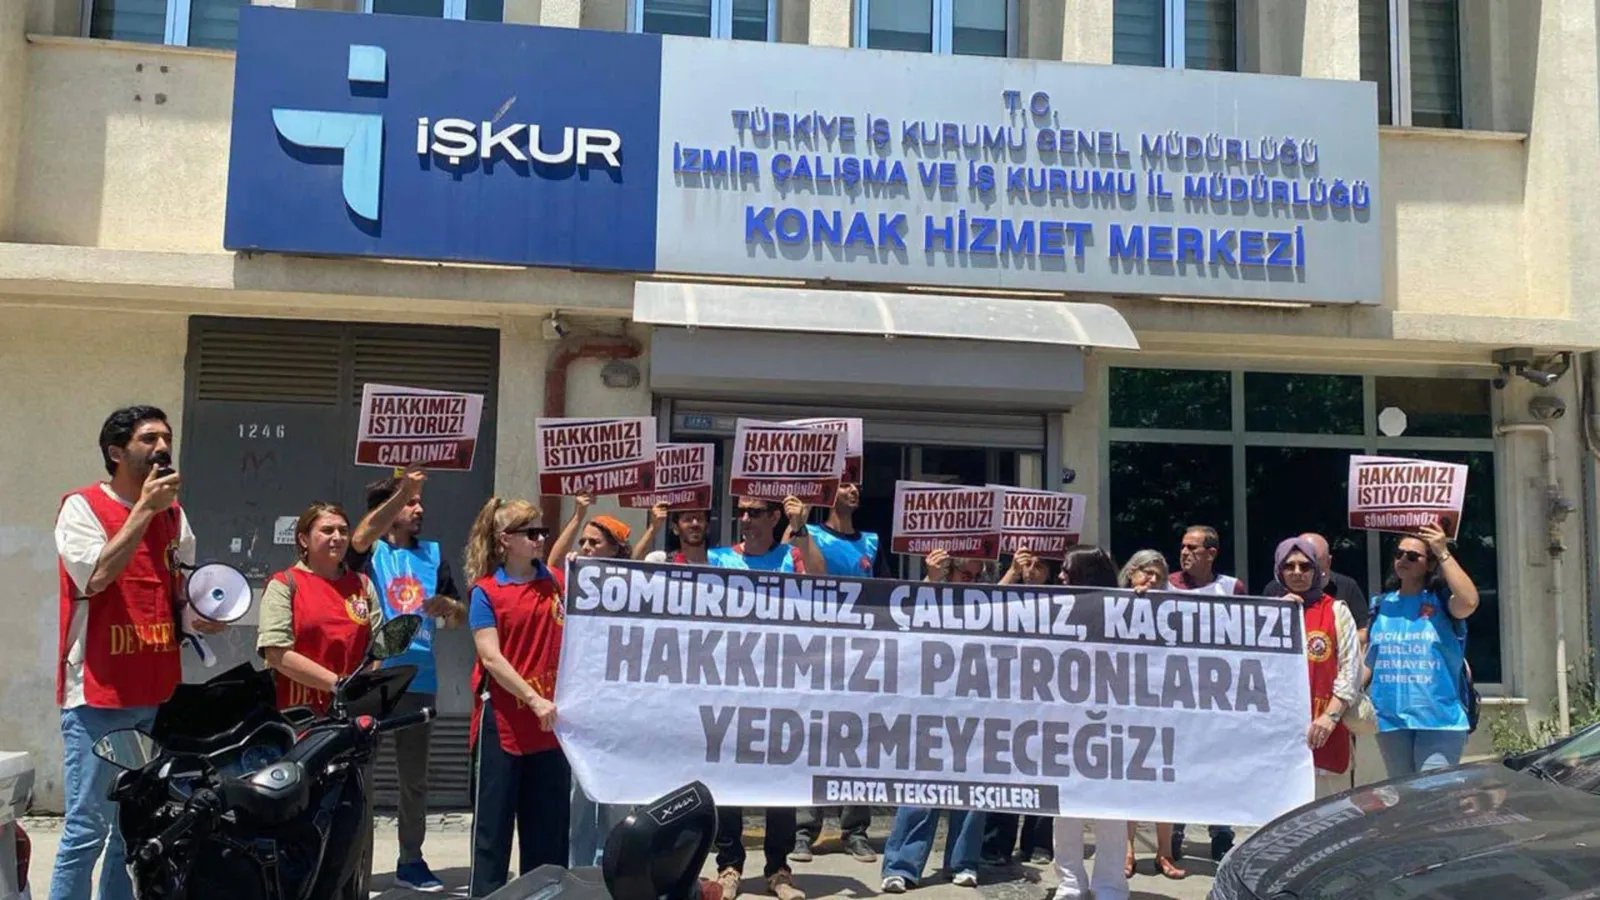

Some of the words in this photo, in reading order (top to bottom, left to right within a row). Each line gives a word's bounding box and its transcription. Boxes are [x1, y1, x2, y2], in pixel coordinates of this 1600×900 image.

[1003, 90, 1059, 120] T.C.
[416, 116, 621, 168] İŞKUR
[732, 107, 856, 141] TÜRKİYE
[902, 120, 1027, 151] KURUMU
[1037, 128, 1129, 157] GENEL
[1141, 131, 1318, 165] MÜDÜRLÜĞÜ
[674, 141, 760, 177] İZMİR
[771, 152, 908, 186] ÇALIŞMA
[918, 161, 958, 187] VE
[969, 159, 996, 191] İŞ
[1007, 166, 1136, 197] KURUMU
[1147, 168, 1173, 200] İL
[1184, 172, 1370, 209] MÜDÜRLÜĞÜ
[745, 205, 908, 250] KONAK
[925, 208, 1093, 258] HİZMET
[1109, 224, 1305, 267] MERKEZİ
[370, 398, 467, 415] HAKKIMIZI
[368, 415, 465, 434] İSTİYORUZ!
[543, 421, 641, 447] HAKKIMIZI
[745, 432, 838, 452] HAKKIMIZI
[378, 442, 458, 464] ÇALDINIZ!
[544, 439, 642, 467] İSTİYORUZ!
[656, 447, 704, 467] KIMIZI
[742, 452, 836, 473] İSTİYORUZ!
[656, 464, 704, 485] ORUZ!
[1358, 466, 1456, 485] HAKKIMIZI
[747, 482, 822, 497] SÖMÜRDÜNÜZ!
[1357, 485, 1452, 505] İSTİYORUZ!
[904, 491, 995, 511] HAKKIMIZI
[903, 509, 992, 531] İSTİYORUZ!
[1002, 511, 1071, 529] TİYORUZ!
[1364, 511, 1439, 528] SÖMÜRDÜNÜZ!
[908, 537, 981, 553] SÖMÜRDÜNÜZ!
[575, 565, 875, 630] SÖMÜRDÜNÜZ,
[889, 584, 1088, 642] ÇALDINIZ,
[1104, 595, 1293, 649] KAÇTINIZ!
[605, 624, 899, 695] HAKKIMIZI
[921, 640, 1270, 713] PATRONLARA
[1375, 659, 1441, 671] ERMAYEYİ
[700, 705, 1176, 782] YEDİRMEYECEĞİZ!
[826, 780, 888, 803] BARTA
[893, 783, 963, 806] TEKSTİL
[969, 785, 1040, 810] İŞÇİLERİ
